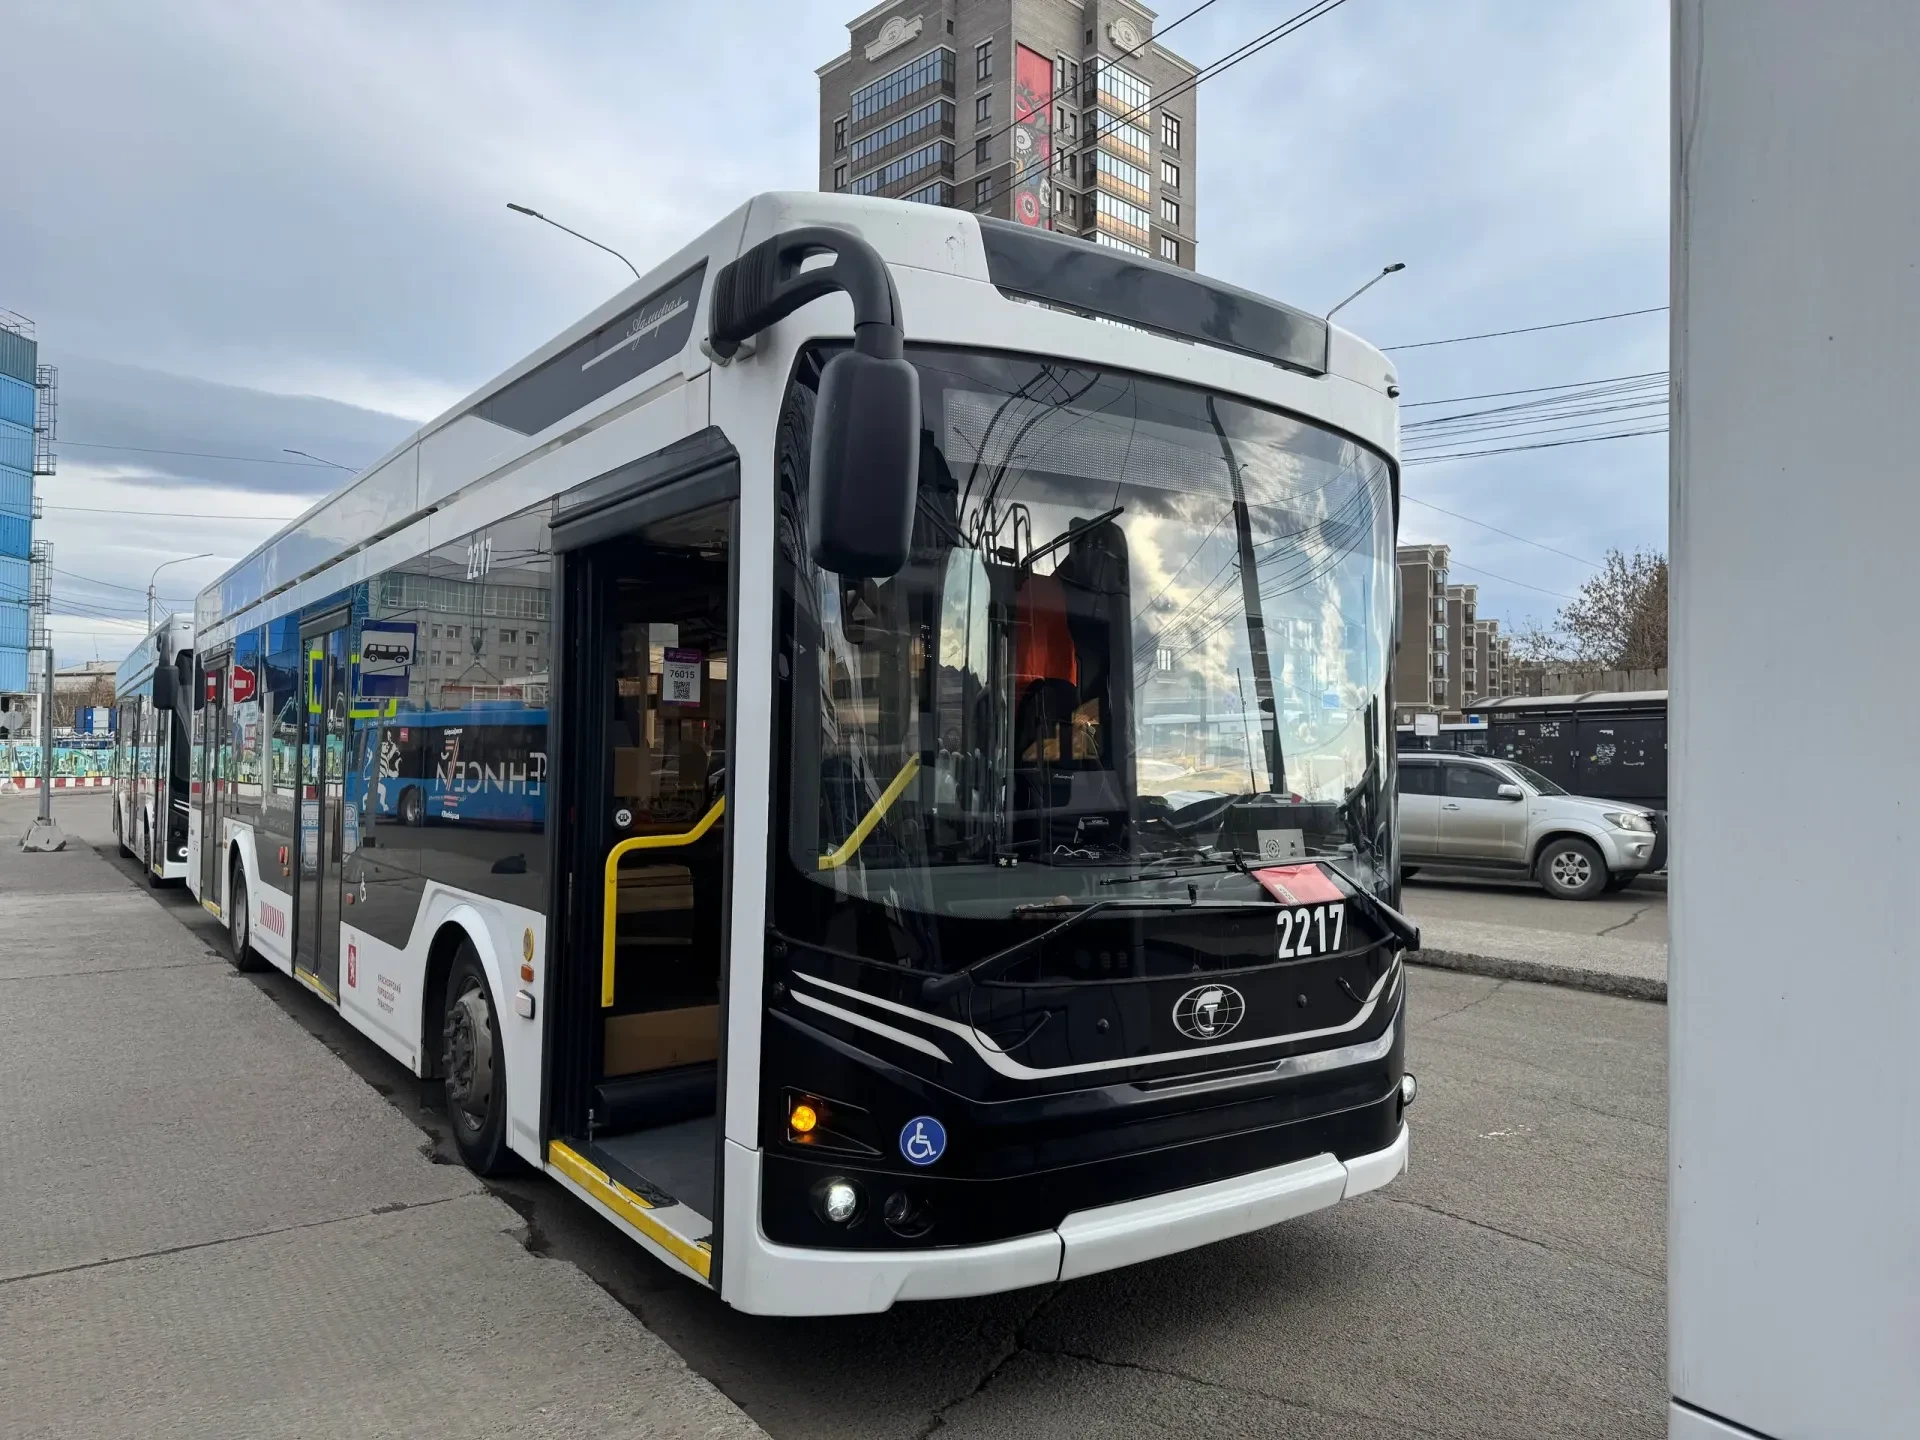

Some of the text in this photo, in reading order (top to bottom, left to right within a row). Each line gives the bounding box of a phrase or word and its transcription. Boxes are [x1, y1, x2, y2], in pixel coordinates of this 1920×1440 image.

[467, 537, 492, 580] 2217
[669, 670, 695, 679] 76015
[1276, 903, 1345, 959] 2217
